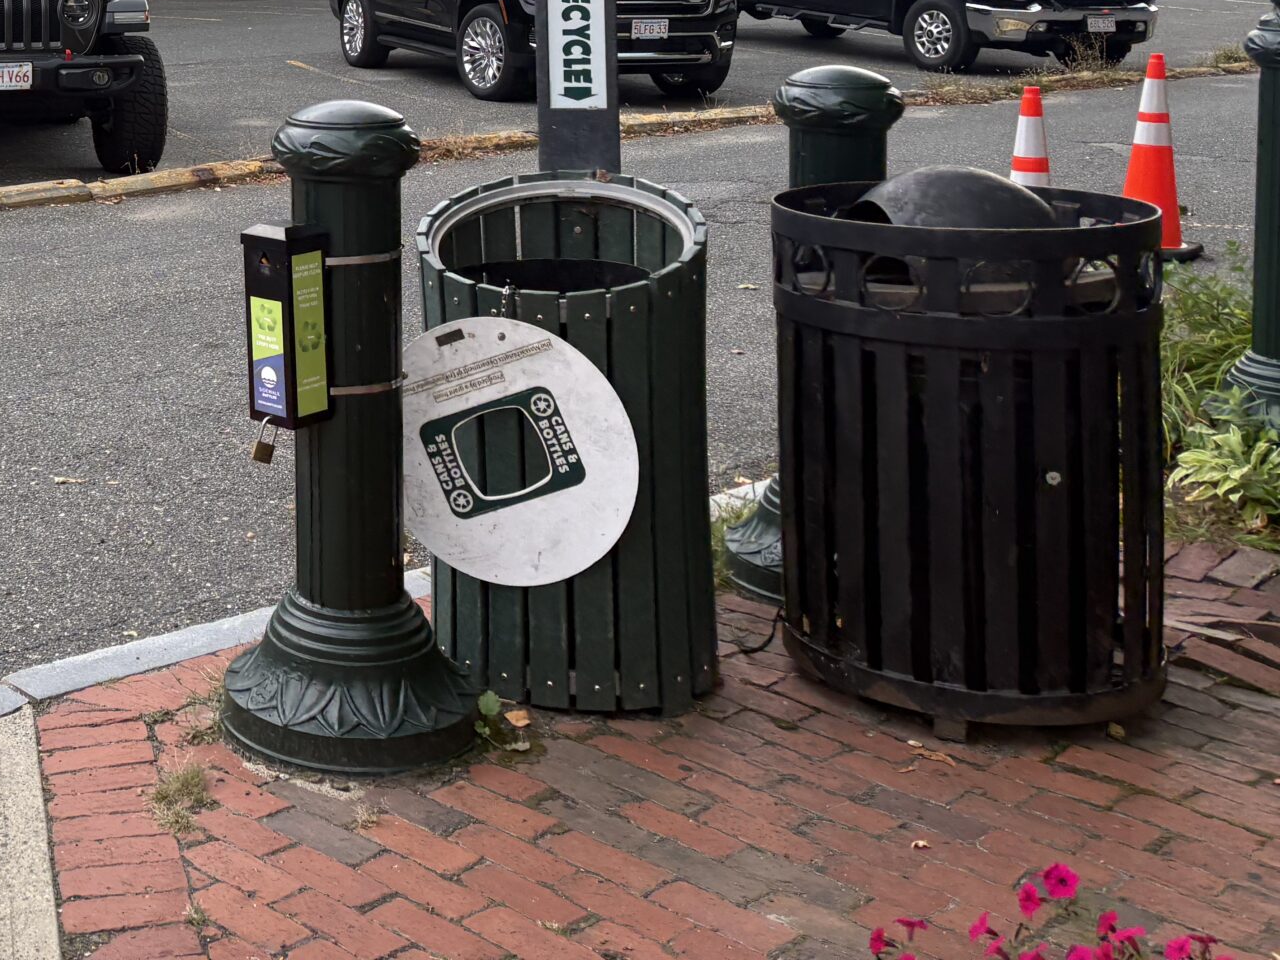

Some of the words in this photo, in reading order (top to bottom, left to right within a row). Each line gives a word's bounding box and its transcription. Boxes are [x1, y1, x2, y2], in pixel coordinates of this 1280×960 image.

[656, 24, 667, 34] 33
[7, 70, 30, 83] V66
[427, 444, 438, 453] &
[538, 419, 569, 474] BOTTLES
[550, 415, 574, 451] CANS
[567, 454, 578, 463] &
[431, 457, 453, 490] CANS
[435, 434, 466, 487] BOTTLES
